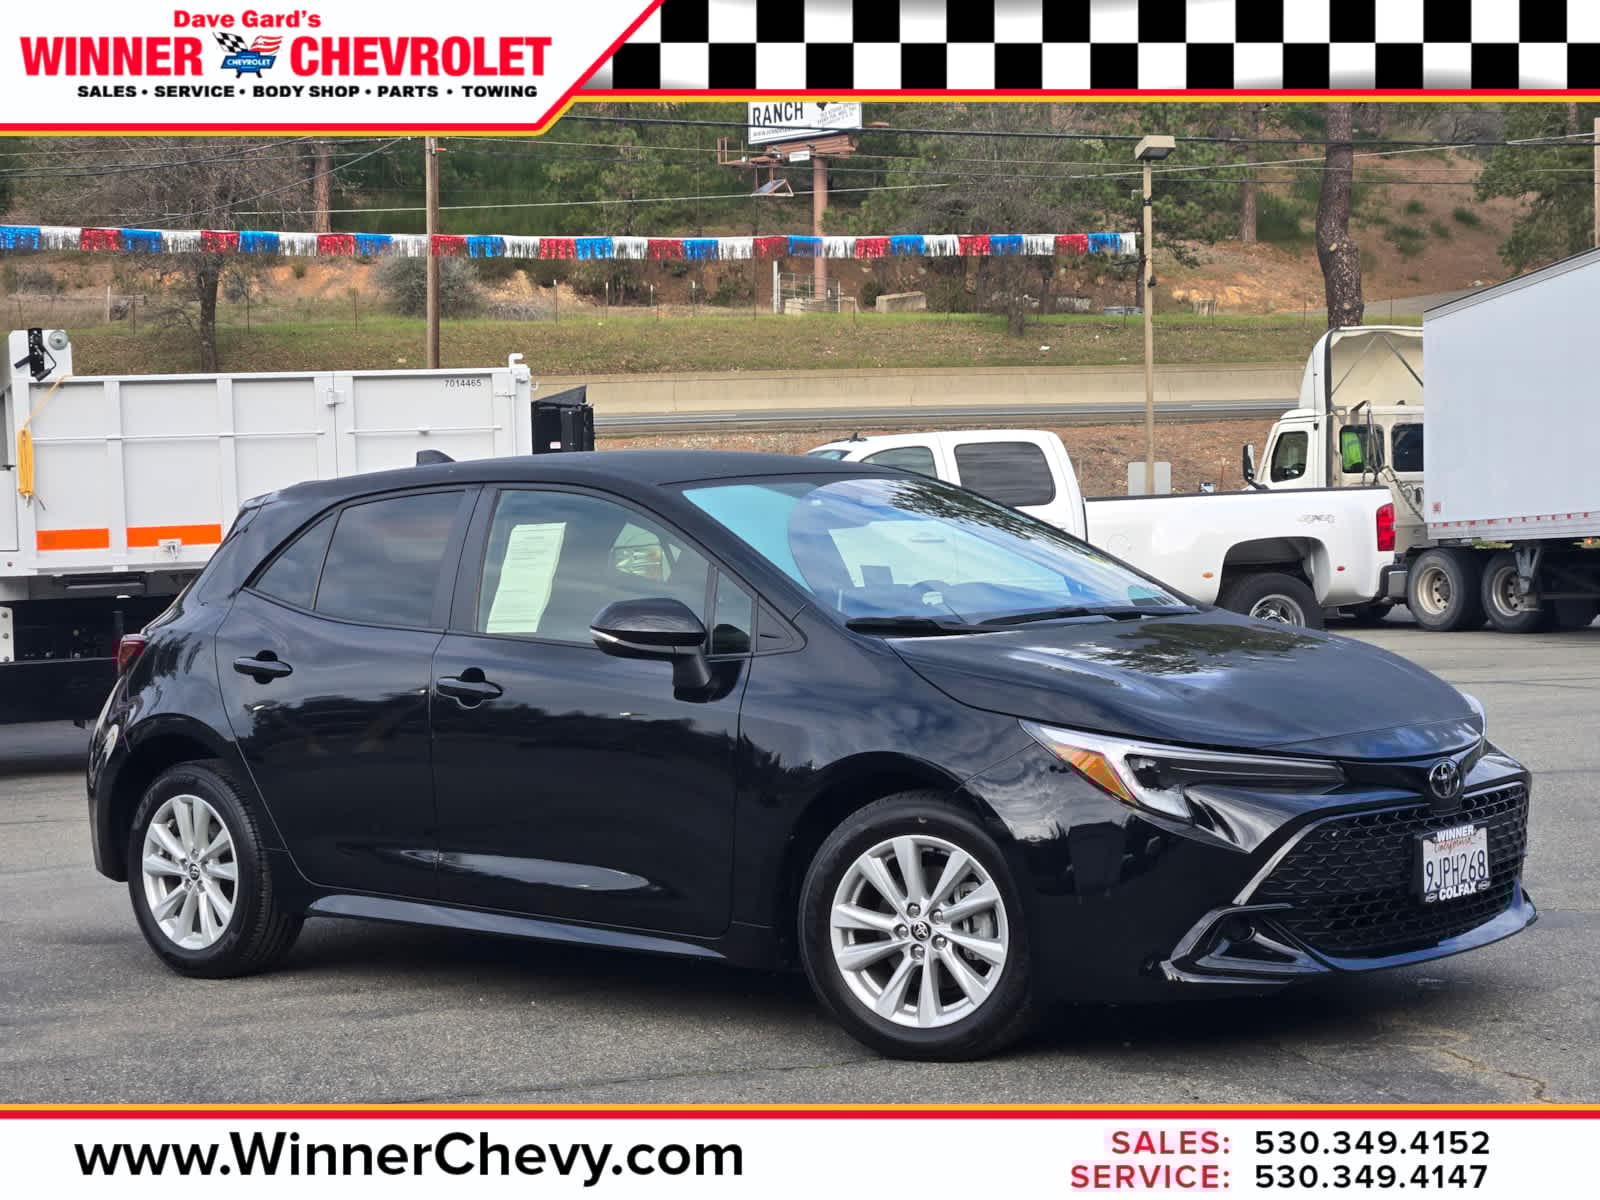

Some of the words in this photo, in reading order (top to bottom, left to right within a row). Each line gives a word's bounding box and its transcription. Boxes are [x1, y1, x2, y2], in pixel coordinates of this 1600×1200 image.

[753, 102, 804, 127] RANCH
[444, 379, 482, 388] 7014465
[1436, 824, 1475, 842] WINNER
[1426, 849, 1486, 892] 9JPH268
[1438, 881, 1477, 901] COLFAX
